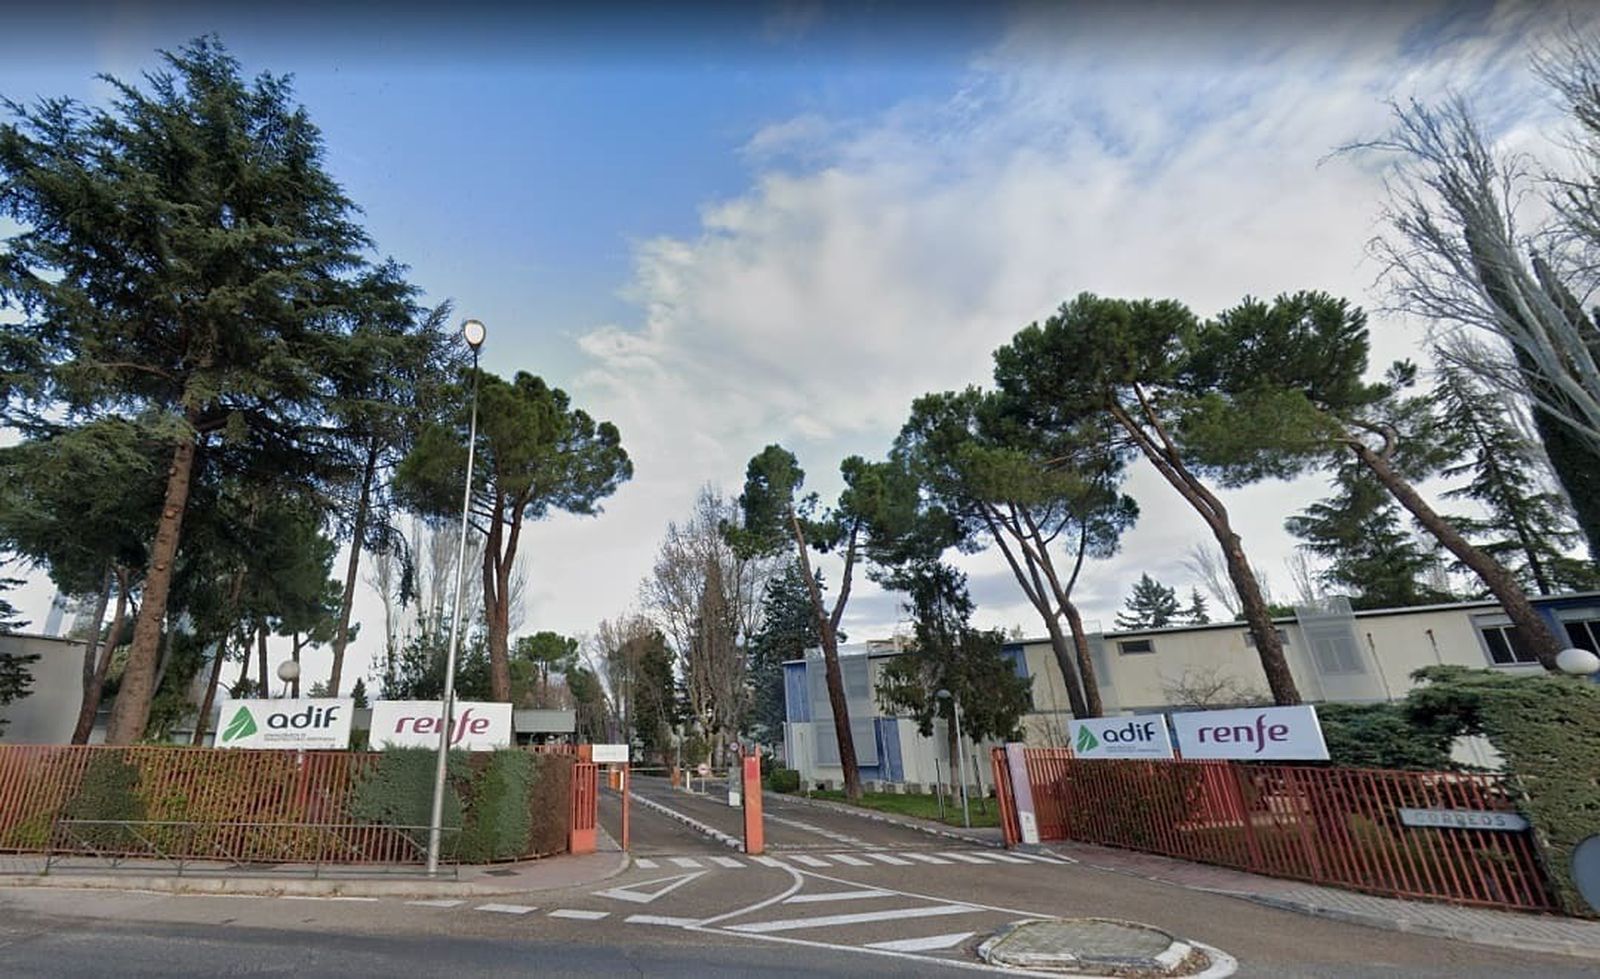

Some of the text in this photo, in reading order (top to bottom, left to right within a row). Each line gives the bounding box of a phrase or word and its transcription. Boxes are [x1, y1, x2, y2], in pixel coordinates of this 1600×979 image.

[266, 705, 341, 729] adif
[1103, 722, 1155, 742] adif
[1198, 714, 1289, 753] renfe
[1414, 811, 1506, 827] CORREOS
